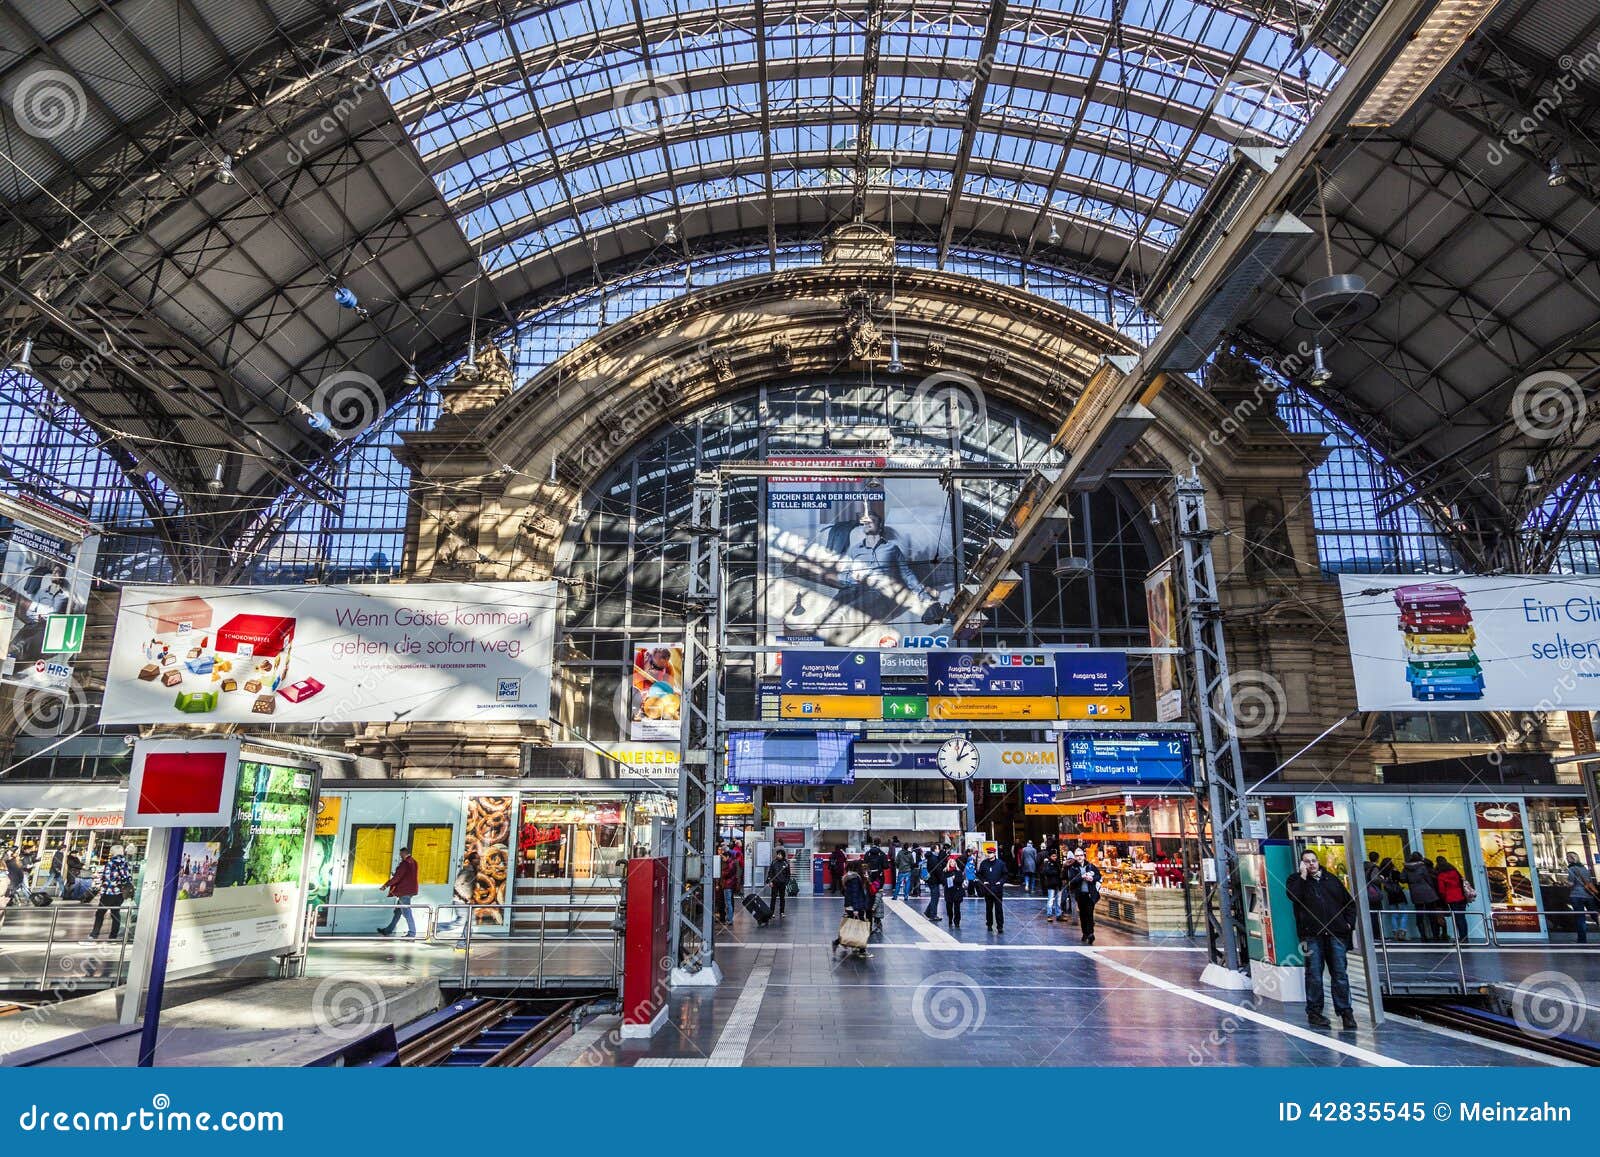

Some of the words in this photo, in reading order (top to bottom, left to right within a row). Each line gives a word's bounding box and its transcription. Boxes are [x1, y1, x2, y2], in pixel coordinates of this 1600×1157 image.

[772, 493, 801, 501] SUCHEN
[803, 493, 815, 501] SIE
[816, 493, 828, 501] AN
[828, 493, 843, 501] DER
[845, 493, 884, 501] RICHTIGEN
[772, 501, 800, 509] STELLE:
[802, 501, 827, 509] HRS.de
[1523, 597, 1559, 623] Ein
[336, 607, 389, 627] Wenn
[394, 607, 449, 627] Gäste
[454, 603, 533, 631] kommen,
[332, 634, 388, 661] gehen
[394, 633, 422, 654] die
[428, 632, 476, 654] sofort
[480, 639, 525, 658] weg.
[881, 658, 897, 667] Das
[47, 663, 69, 677] HRS
[737, 740, 750, 753] 13
[1167, 741, 1181, 754] 12
[1001, 750, 1056, 765] COMM
[628, 766, 649, 775] Bank
[652, 767, 662, 775] an
[1095, 765, 1125, 775] Stuttgart
[1126, 765, 1138, 773] Hbf
